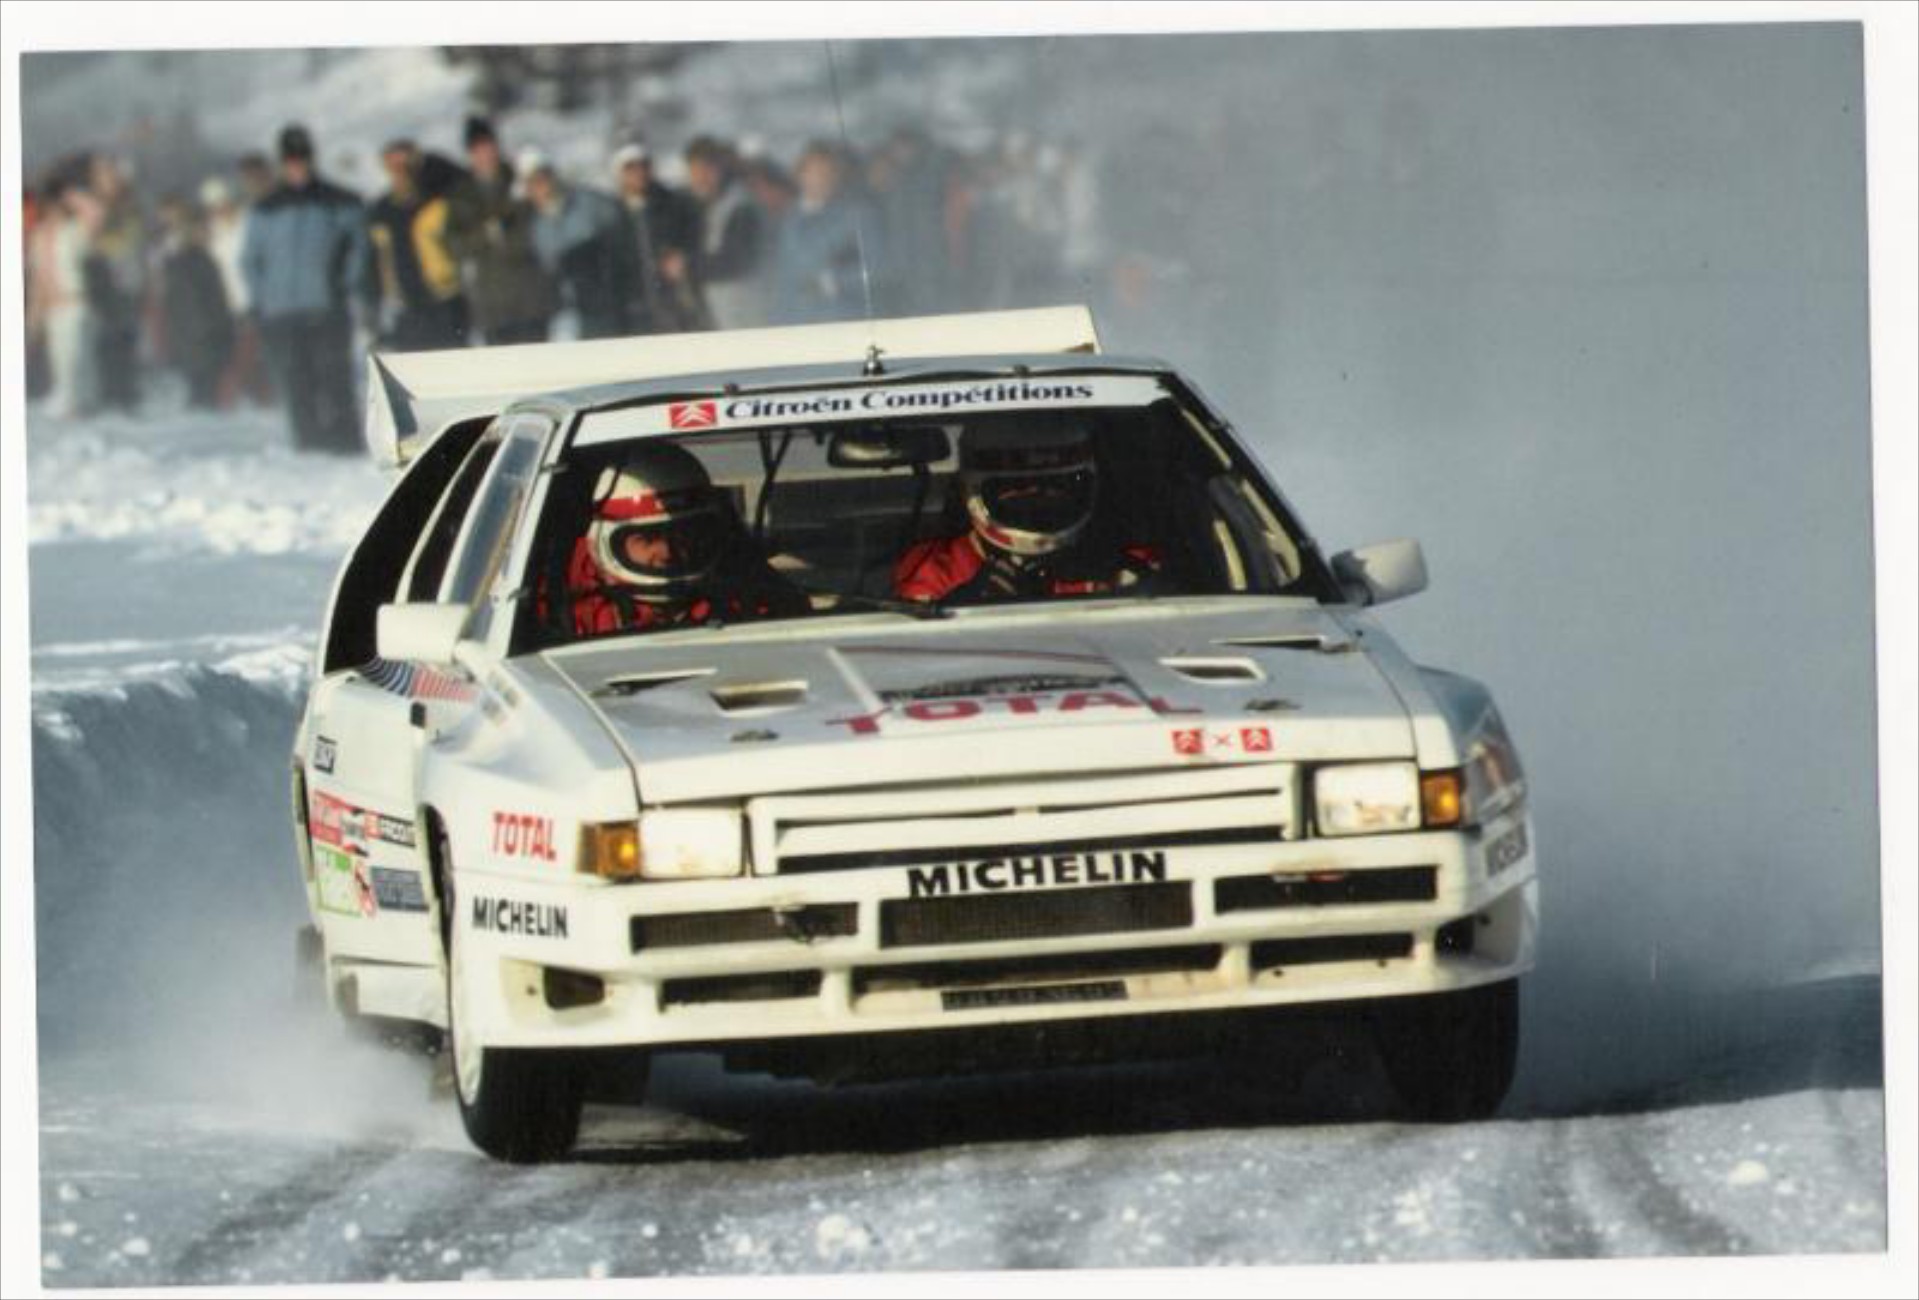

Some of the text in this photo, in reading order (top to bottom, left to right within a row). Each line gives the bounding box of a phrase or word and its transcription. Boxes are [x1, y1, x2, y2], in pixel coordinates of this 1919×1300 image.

[726, 383, 1094, 419] Citroën Compétitions
[824, 692, 1202, 734] TOTAL
[491, 811, 557, 862] TOTAL
[907, 850, 1167, 899] MICHELIN
[472, 896, 569, 938] MICHELIN
